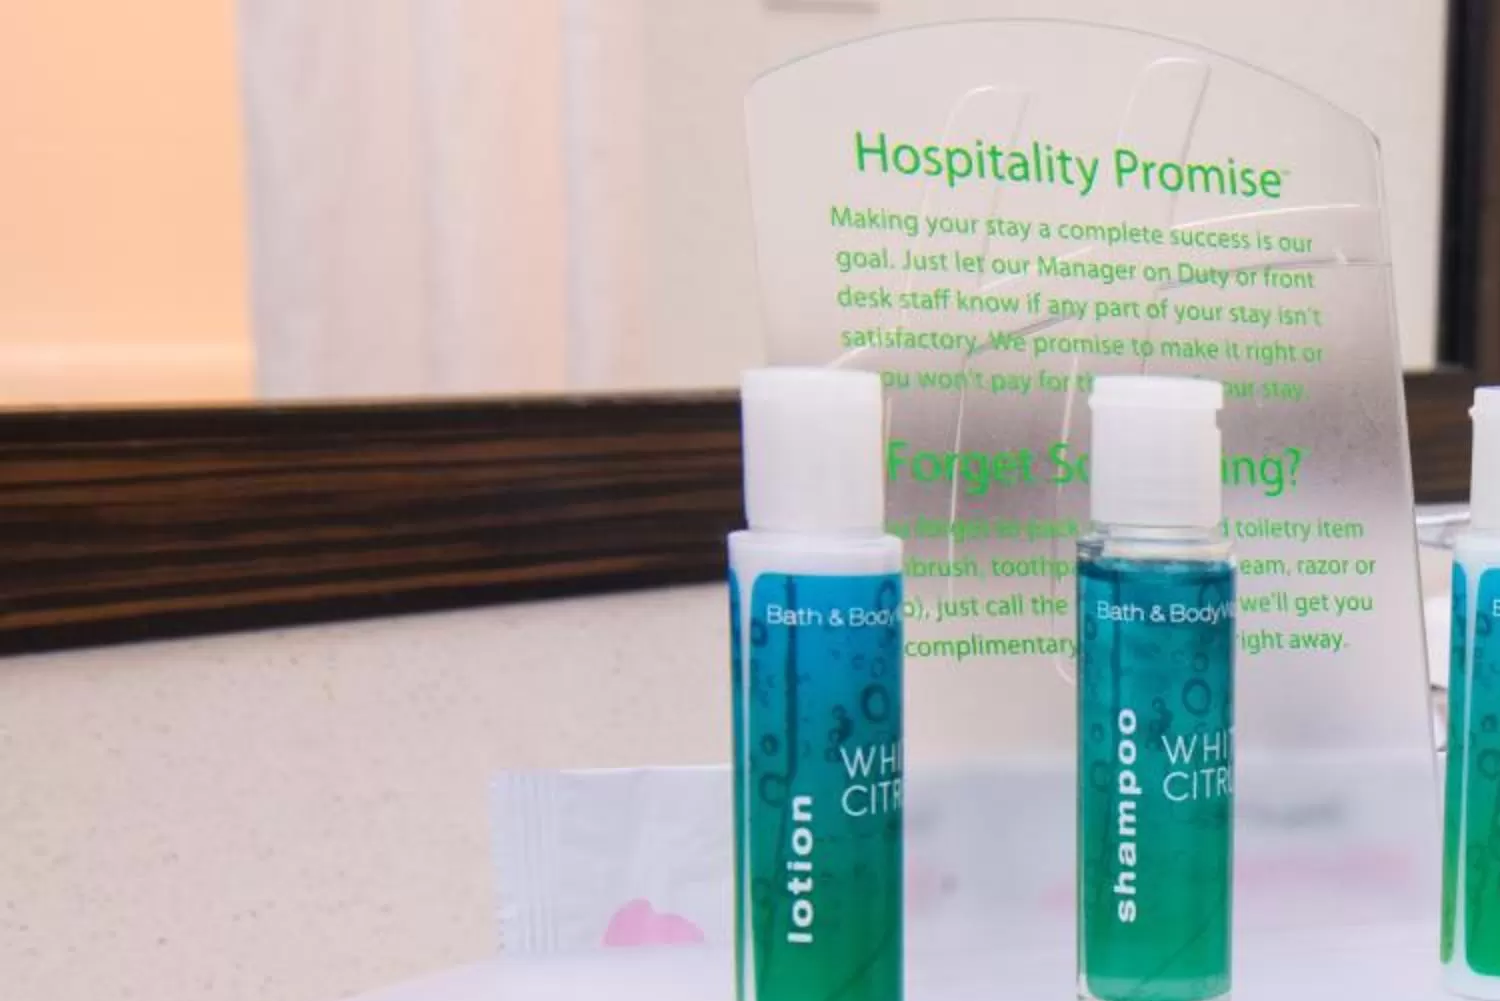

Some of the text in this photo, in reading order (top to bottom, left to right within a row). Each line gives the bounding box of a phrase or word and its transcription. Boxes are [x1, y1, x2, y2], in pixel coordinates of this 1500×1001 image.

[854, 130, 1283, 199] Hospitality Promise
[830, 204, 1313, 253] Making your stay a complete success is our
[835, 247, 1315, 289] goal. Just let our Manager on Duty or front
[836, 283, 1323, 328] desk staff know if any part of your stay isn't
[989, 330, 1027, 352] We
[1032, 333, 1125, 357] promise
[1131, 336, 1154, 357] to
[1160, 337, 1220, 360] make
[1225, 340, 1241, 361] it
[1247, 340, 1297, 365] right
[1302, 346, 1324, 363] or
[880, 370, 910, 389] ou
[917, 368, 985, 390] won't
[991, 371, 1033, 394] pay
[1039, 368, 1069, 392] for
[887, 438, 1034, 496] Forget
[915, 513, 991, 544] forget
[996, 517, 1022, 538] to
[1026, 517, 1078, 542] pack
[1234, 516, 1312, 543] toiletry
[1317, 516, 1365, 539] item
[991, 555, 1073, 584] toothp
[1239, 558, 1292, 577] eam,
[1297, 558, 1349, 576] razor
[1354, 558, 1377, 575] or
[766, 603, 823, 626] Bath
[828, 607, 845, 627] &
[936, 593, 980, 622] just
[985, 593, 1023, 617] call
[1030, 593, 1069, 617] the
[1239, 591, 1288, 613] we'll
[1294, 593, 1329, 617] get
[1334, 597, 1374, 617] you
[1096, 600, 1146, 622] Bath
[1149, 604, 1167, 623] &
[904, 629, 1351, 662] complimentary ight away.
[1160, 727, 1235, 766] WHI
[841, 777, 902, 817] CITR
[1112, 707, 1143, 924] shampoo
[786, 793, 814, 945] lotion
